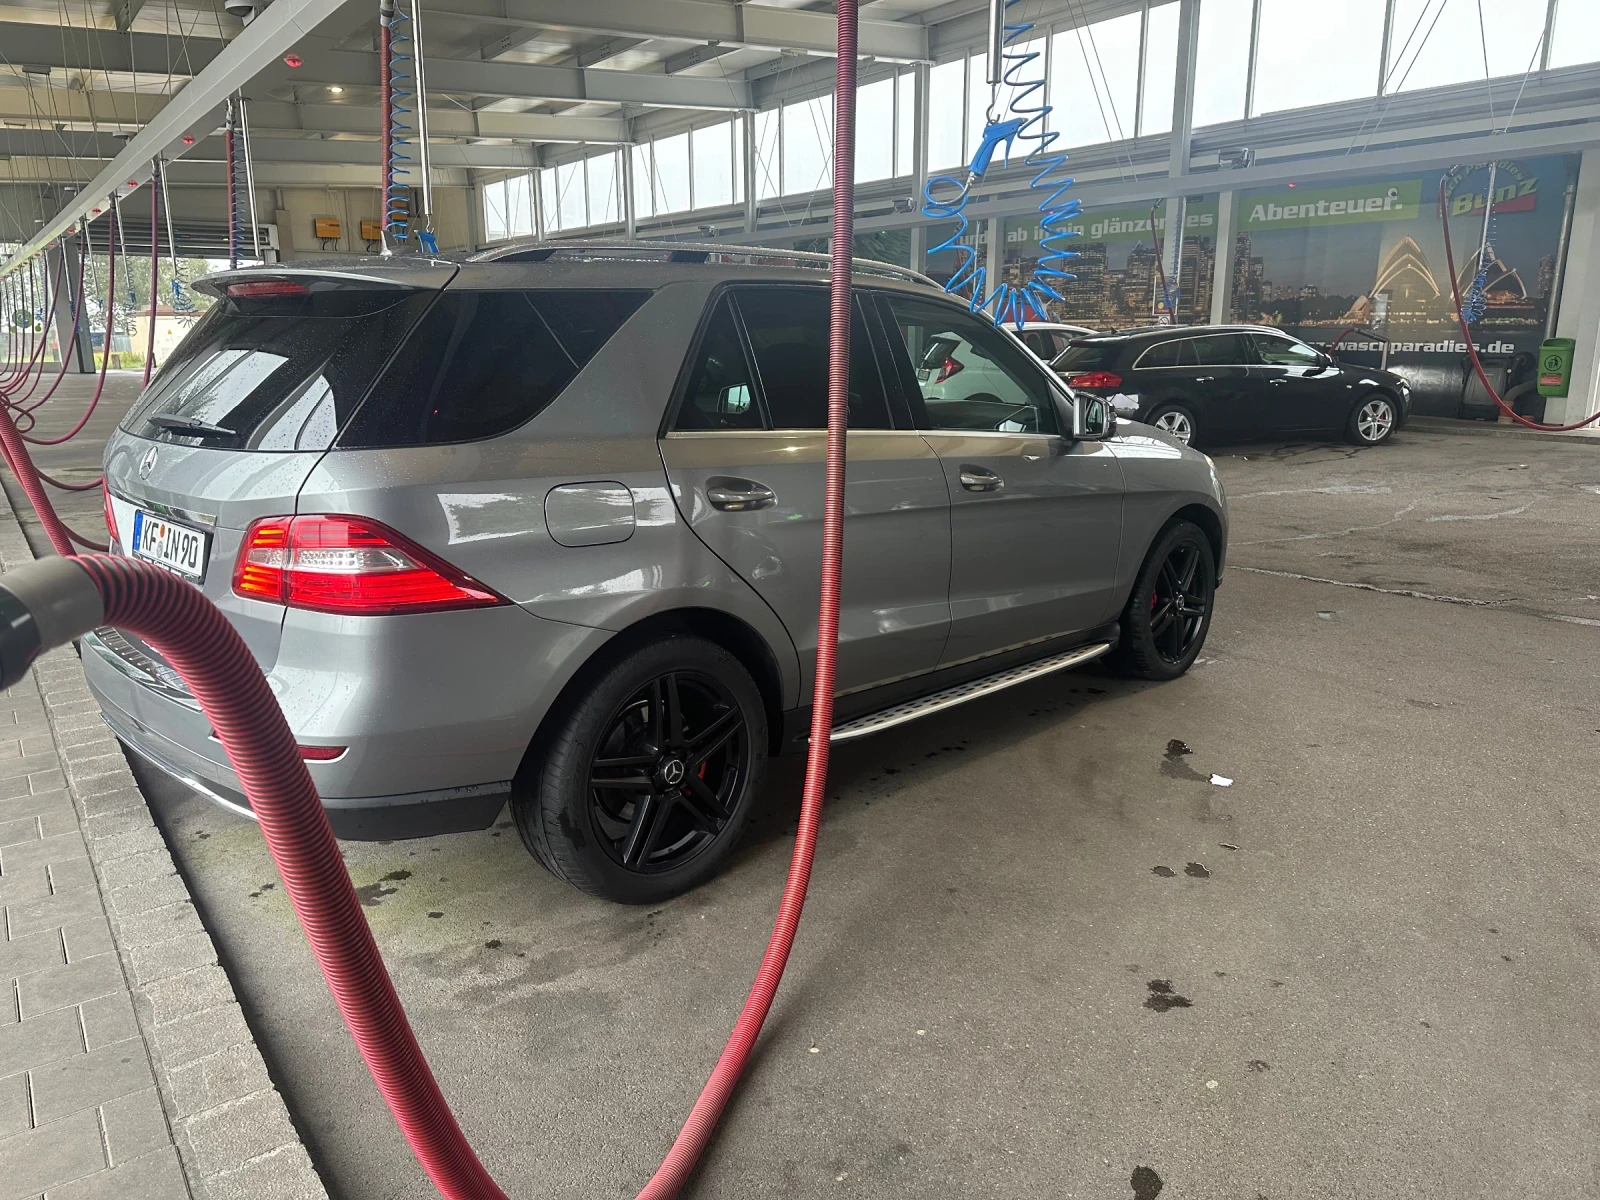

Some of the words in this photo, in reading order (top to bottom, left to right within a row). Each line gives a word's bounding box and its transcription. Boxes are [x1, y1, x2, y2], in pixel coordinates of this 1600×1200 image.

[1249, 195, 1403, 222] Abenteuer.
[1006, 227, 1028, 242] ab
[143, 519, 159, 551] KF
